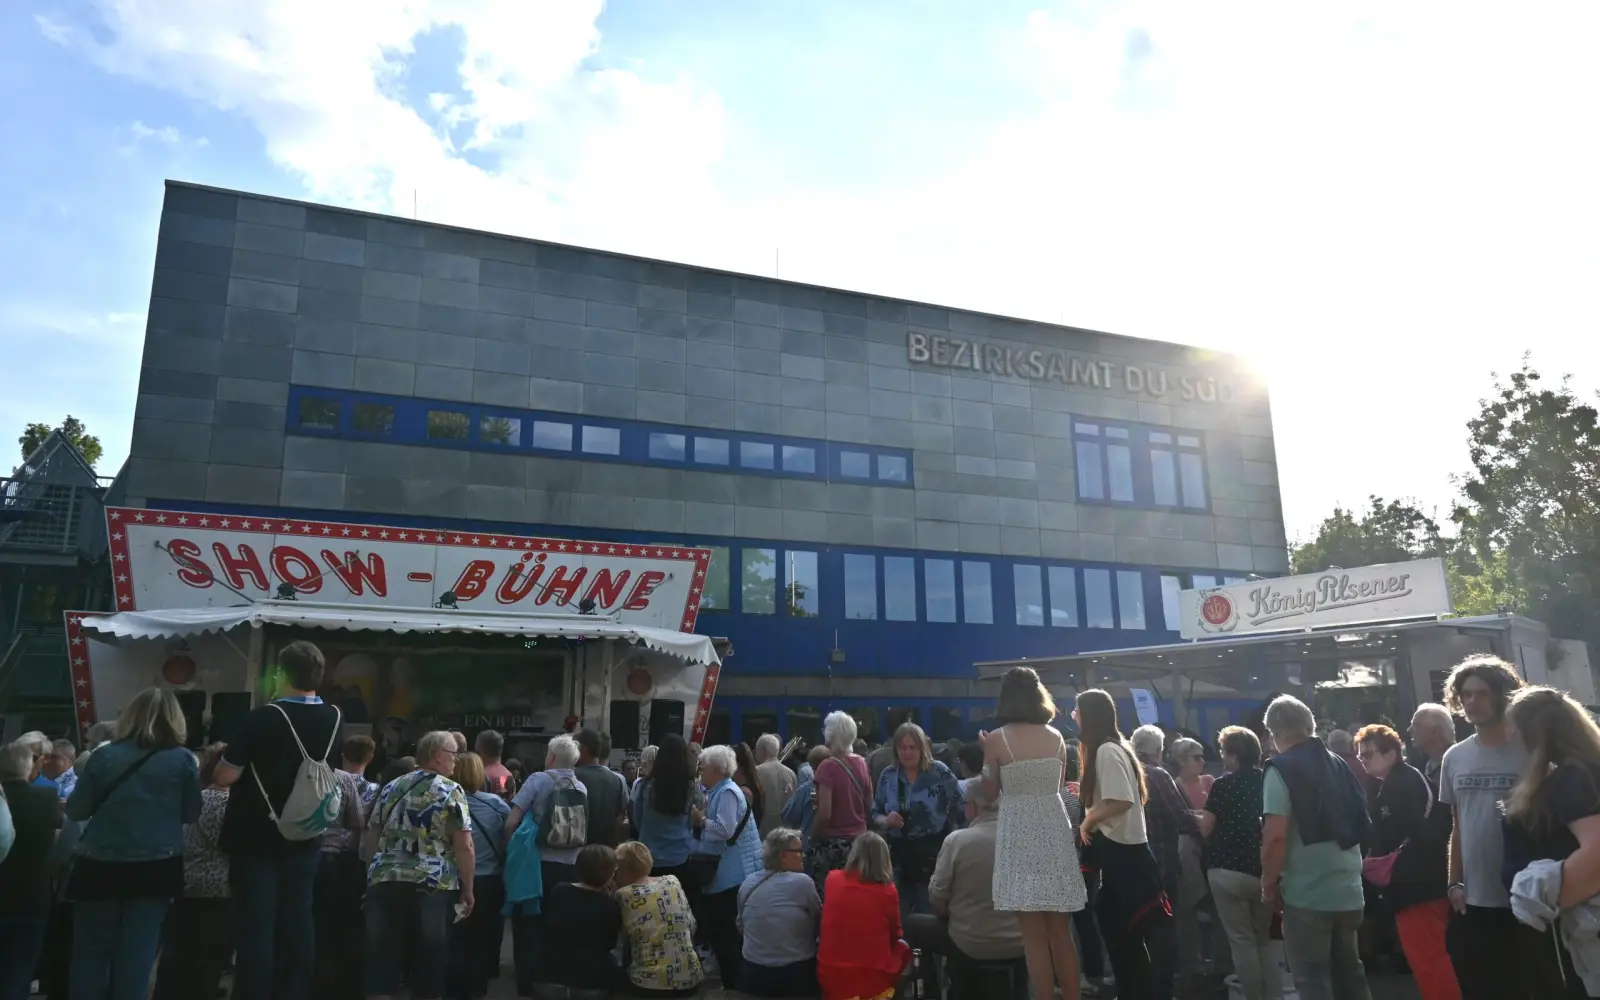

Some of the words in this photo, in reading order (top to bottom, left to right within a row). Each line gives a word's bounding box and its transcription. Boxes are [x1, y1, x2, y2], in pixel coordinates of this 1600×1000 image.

[907, 331, 1115, 391] BEZIRKSAMT
[1124, 365, 1168, 397] DU
[1180, 375, 1236, 405] SÜD
[167, 538, 387, 598] SHOW
[451, 551, 666, 611] BÜHNE
[1246, 585, 1316, 618] König
[1315, 573, 1411, 605] Pilsener
[496, 714, 532, 728] BER
